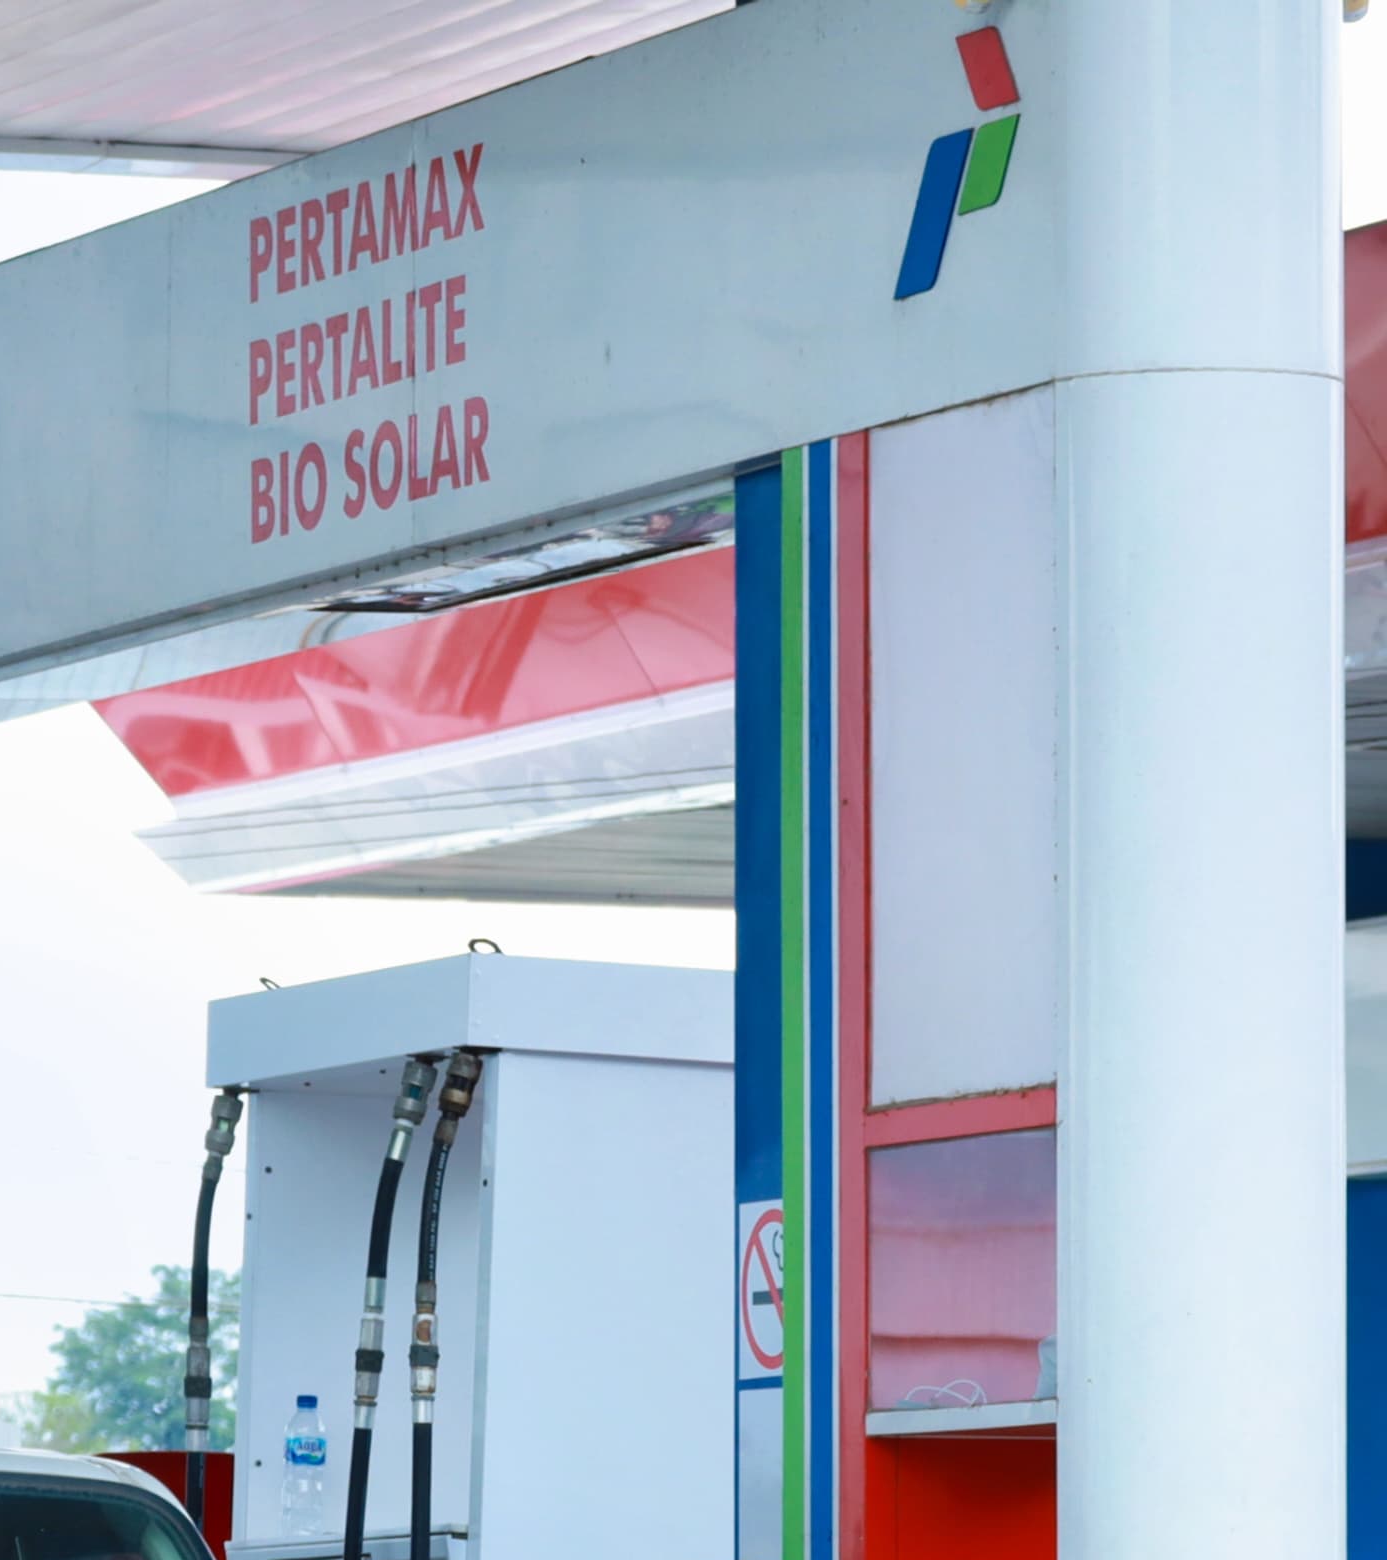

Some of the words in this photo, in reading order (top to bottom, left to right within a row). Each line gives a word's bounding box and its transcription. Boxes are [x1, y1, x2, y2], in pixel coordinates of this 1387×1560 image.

[249, 142, 485, 303] PERTAMAX
[249, 274, 468, 425] PERTALITE
[251, 439, 328, 545] BIO
[342, 396, 491, 520] SOLAR
